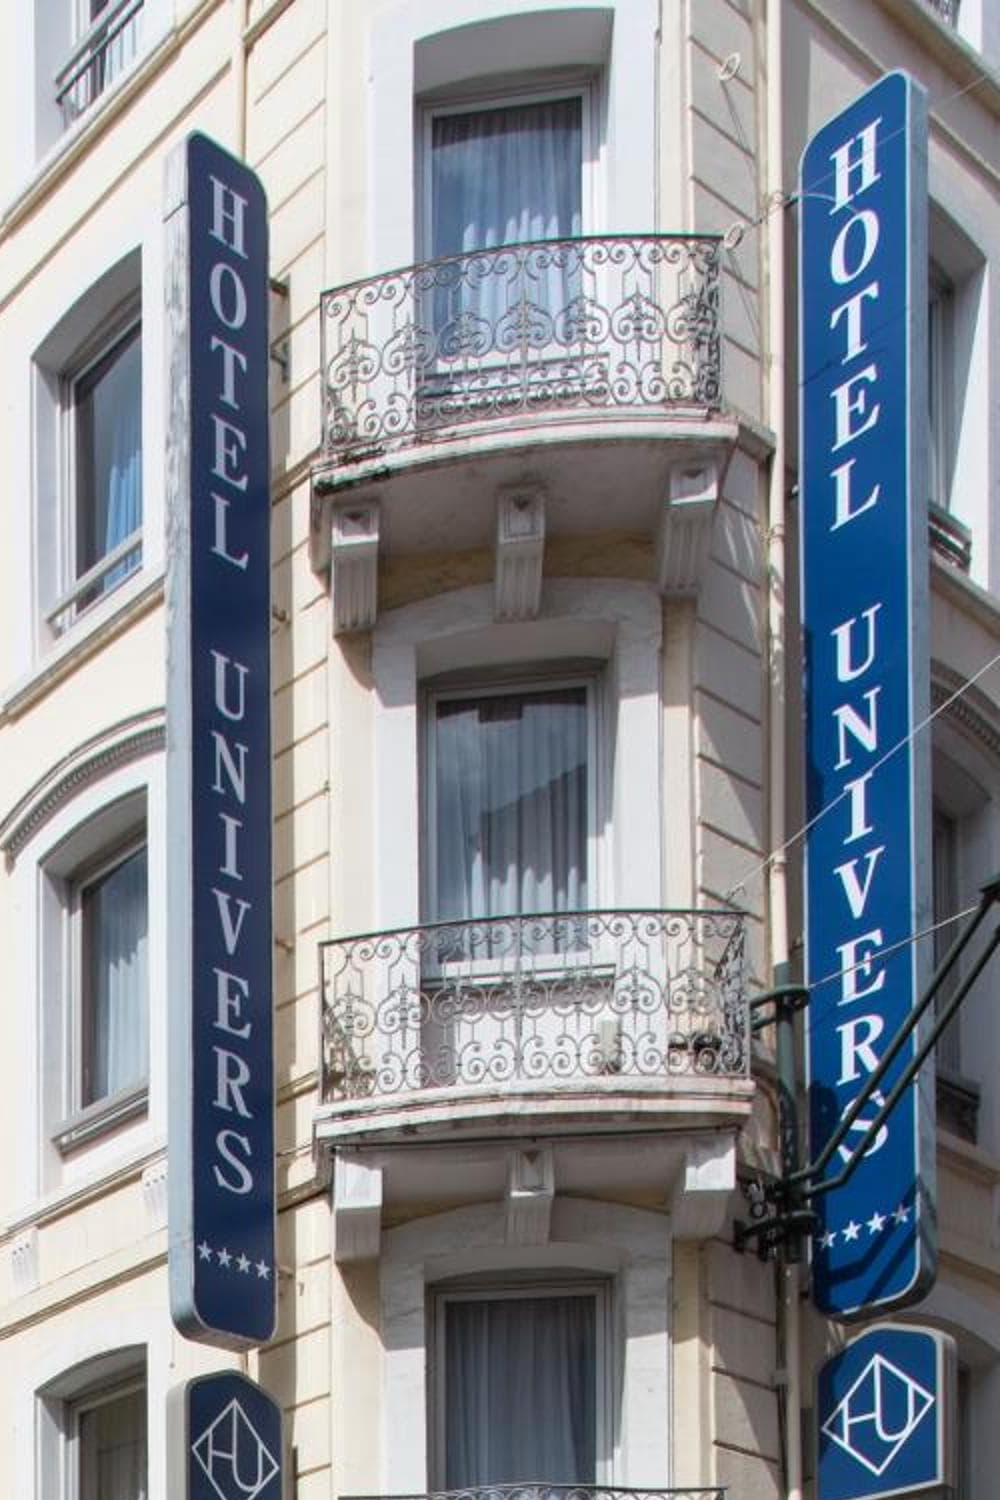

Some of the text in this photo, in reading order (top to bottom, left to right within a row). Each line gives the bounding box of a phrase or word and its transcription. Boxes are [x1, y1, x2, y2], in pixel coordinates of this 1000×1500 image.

[209, 174, 254, 1195] HOTEL UNIVERS
[828, 116, 889, 1159] HOTEL UNIVERS
